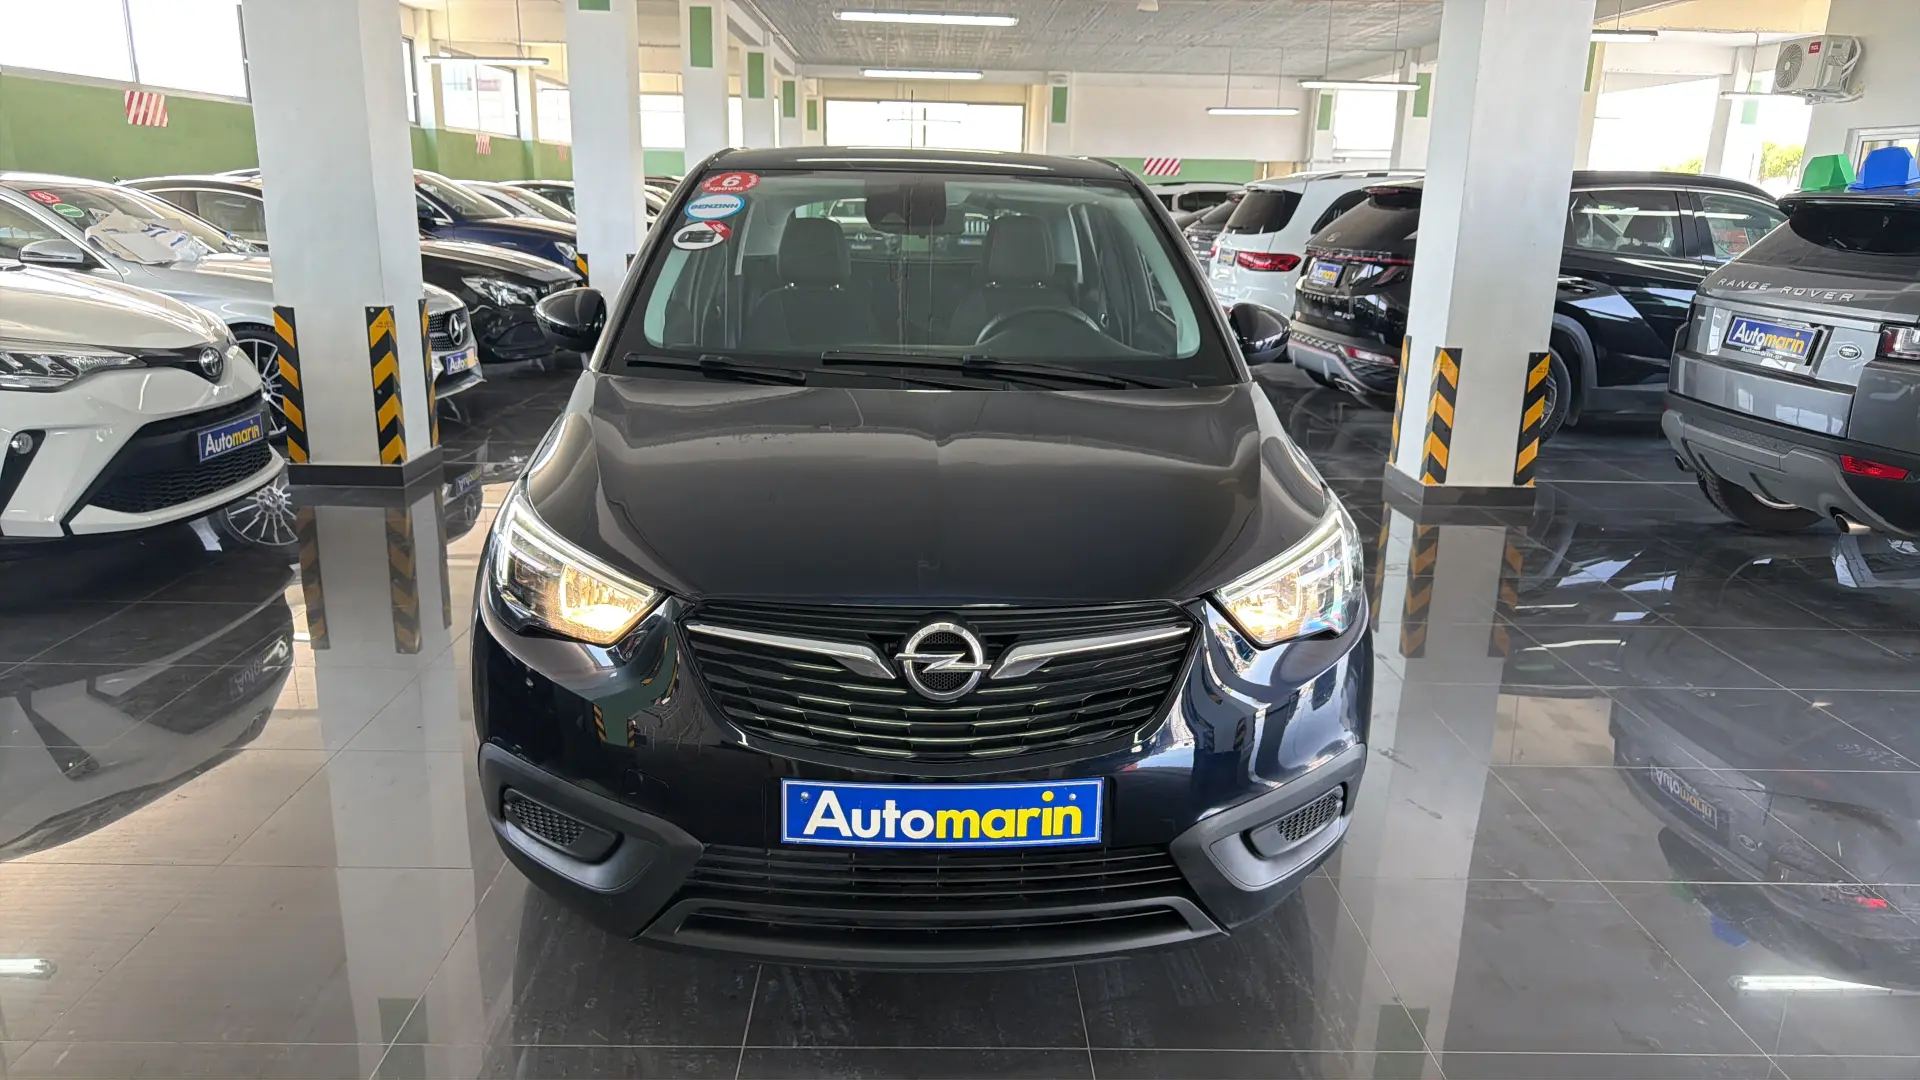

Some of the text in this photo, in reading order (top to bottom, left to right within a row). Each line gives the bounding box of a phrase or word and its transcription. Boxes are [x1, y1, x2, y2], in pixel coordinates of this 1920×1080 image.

[721, 174, 742, 187] 6
[1718, 278, 1854, 302] RANGE ROVER
[1733, 321, 1805, 354] Automarin
[1741, 346, 1783, 361] Automarin.gr
[205, 419, 260, 457] Automarin
[802, 789, 1082, 839] Automarin
